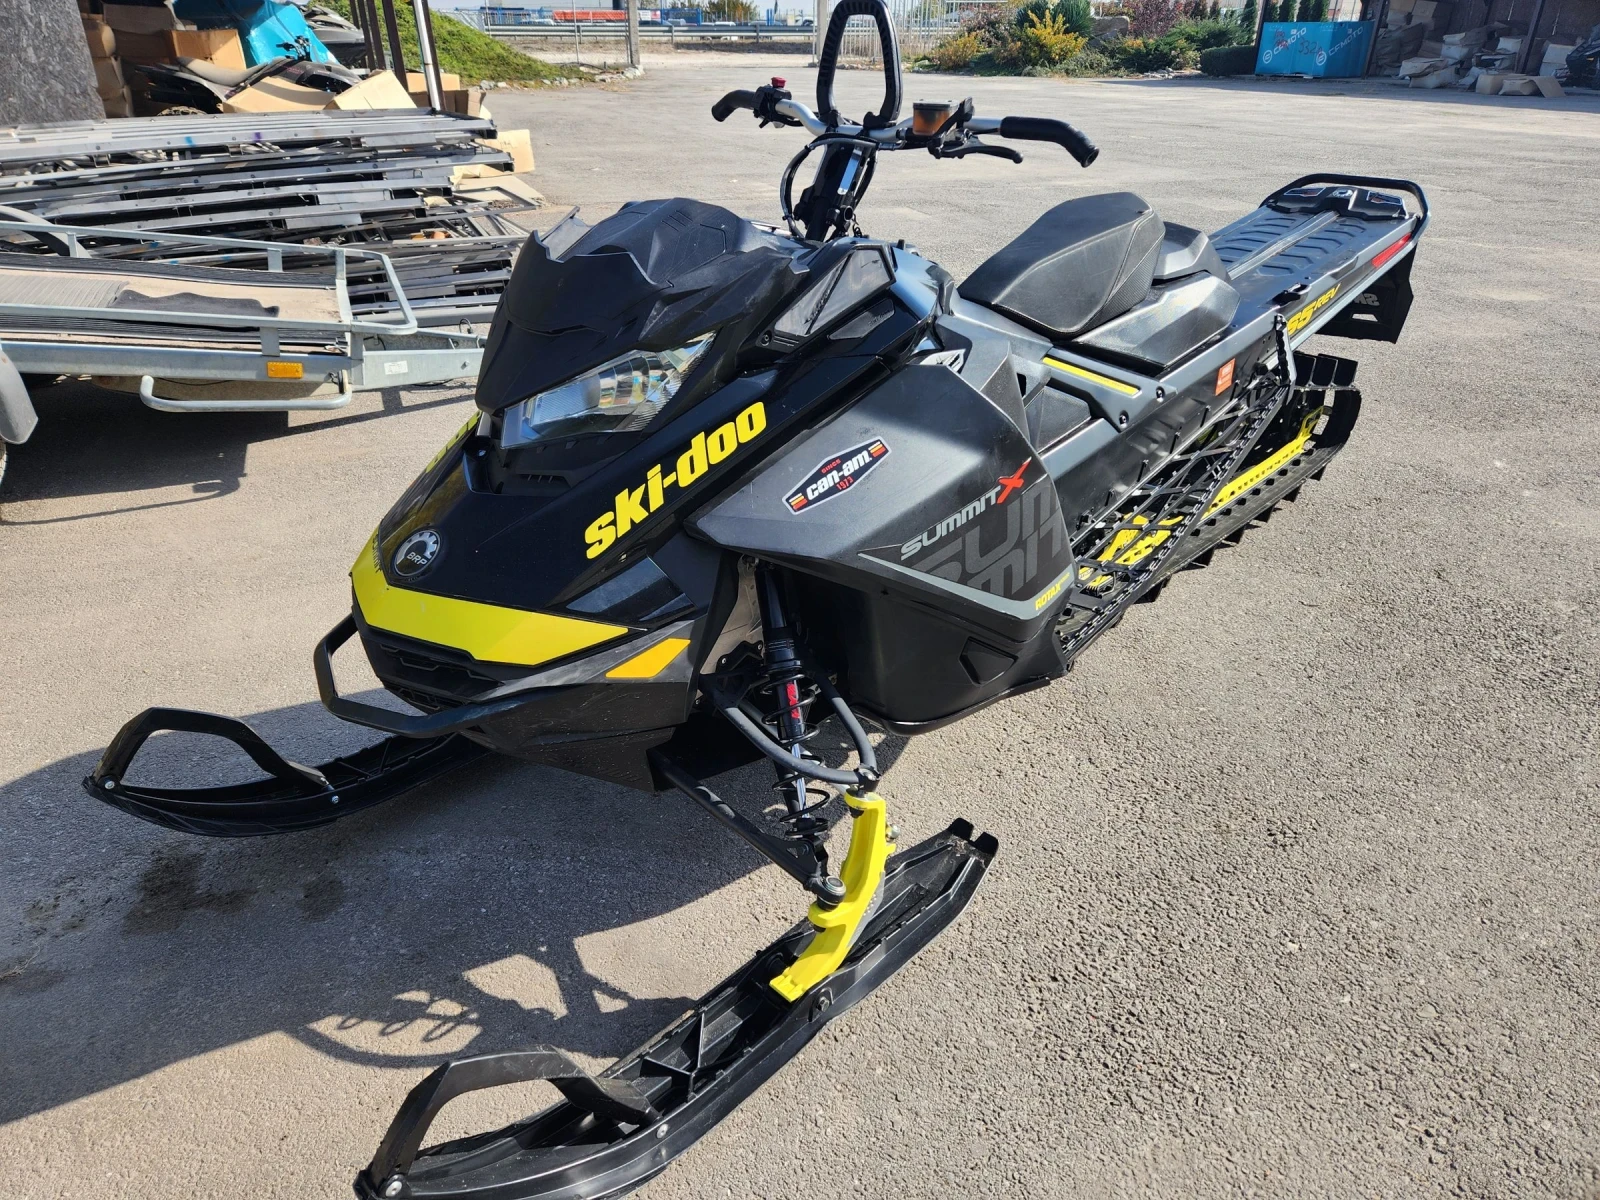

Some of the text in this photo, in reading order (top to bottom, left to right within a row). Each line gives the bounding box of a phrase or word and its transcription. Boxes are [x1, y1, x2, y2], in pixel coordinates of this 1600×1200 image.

[584, 401, 767, 560] ski-doo
[836, 476, 854, 491] 1973
[407, 551, 427, 566] BRP
[1035, 580, 1062, 611] ROTAX
